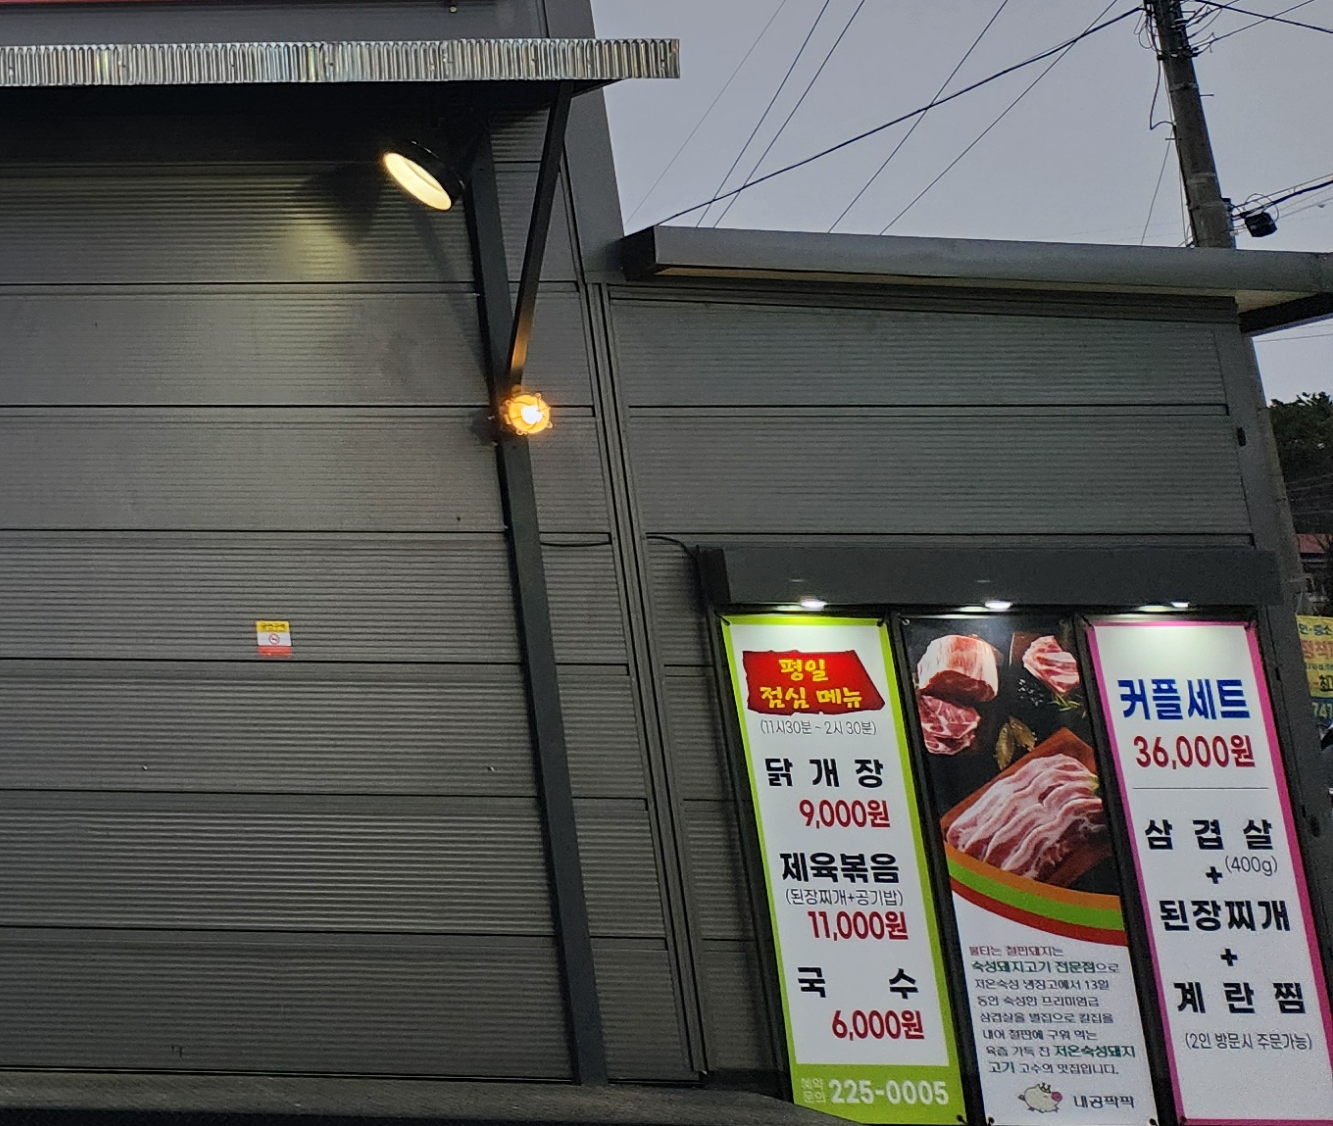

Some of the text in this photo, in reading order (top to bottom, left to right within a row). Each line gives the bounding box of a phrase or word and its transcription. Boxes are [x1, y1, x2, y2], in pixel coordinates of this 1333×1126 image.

[778, 659, 828, 681] 평일
[760, 686, 863, 709] 점심 메뉴
[1117, 678, 1251, 720] 커플세트
[1133, 734, 1256, 770] 36,000원
[799, 799, 891, 829] 9,000원
[780, 852, 899, 883] 제육볶음
[1225, 855, 1278, 876] (400g)
[785, 888, 904, 906] (된장찌개+공기밥)
[807, 910, 909, 941] 11,000원
[1159, 900, 1290, 931] 된장찌개
[832, 1009, 925, 1041] 6,000원
[1185, 1032, 1313, 1050] (2인 방문시 주문가능)
[988, 1061, 1015, 1074] 고기
[829, 1079, 949, 1105] 225-0005
